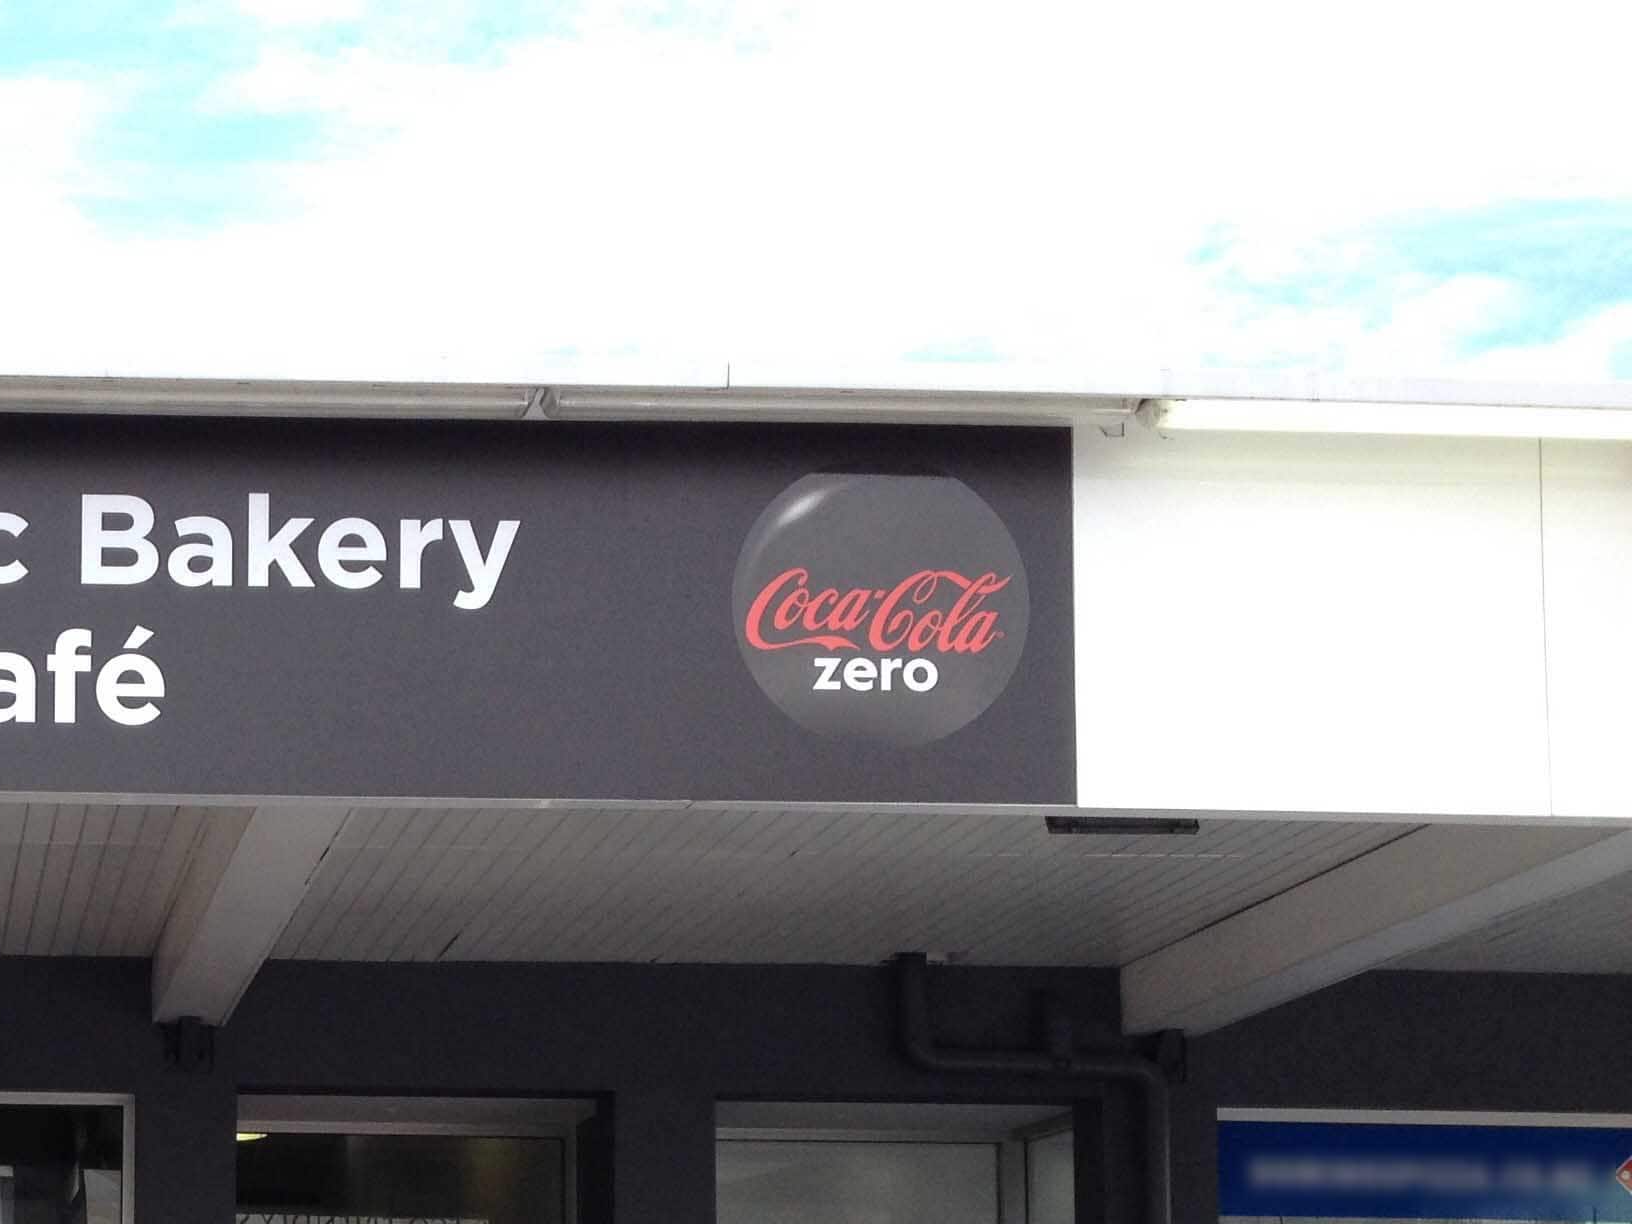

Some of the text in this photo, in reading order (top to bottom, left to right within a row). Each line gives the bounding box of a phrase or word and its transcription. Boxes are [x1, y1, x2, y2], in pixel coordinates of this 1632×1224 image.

[81, 492, 521, 610] Bakery
[745, 567, 1013, 654] Coca-Cola
[812, 656, 939, 692] zero
